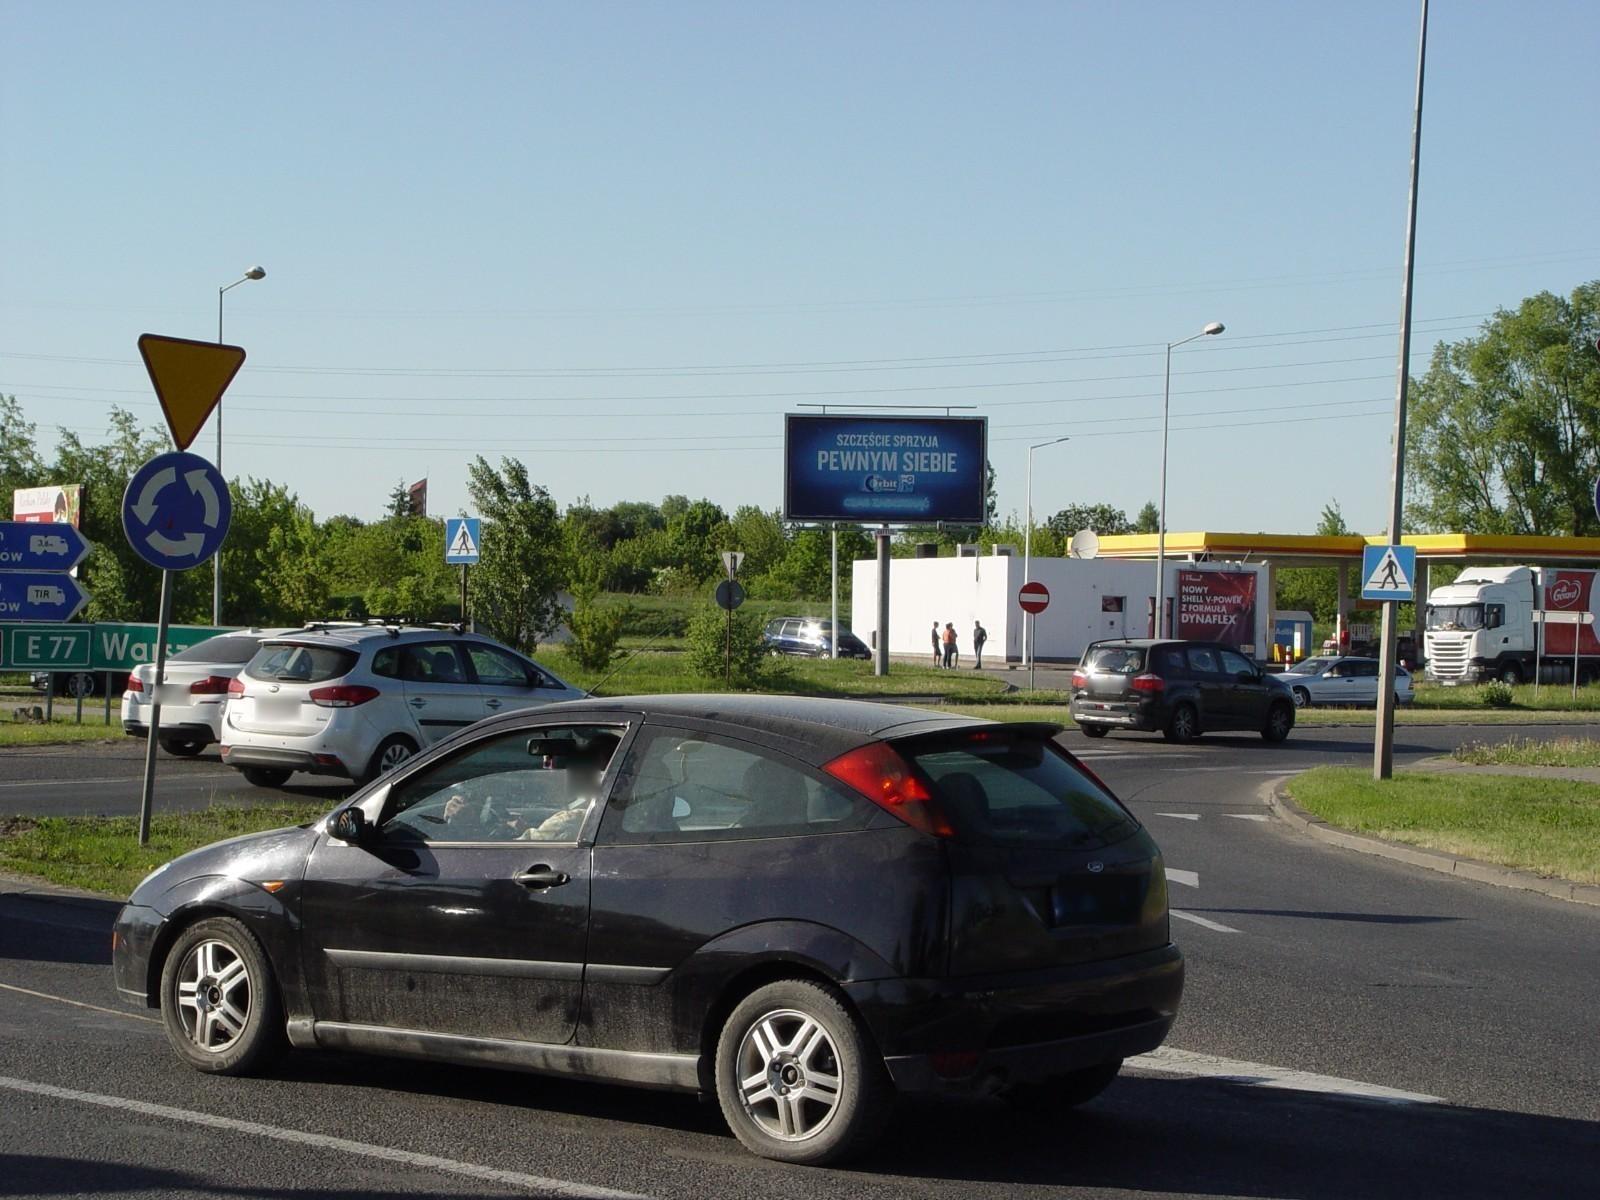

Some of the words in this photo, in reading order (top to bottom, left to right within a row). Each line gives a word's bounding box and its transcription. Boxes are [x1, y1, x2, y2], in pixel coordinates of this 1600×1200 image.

[836, 432, 891, 448] SZCZĘŚCIE
[893, 434, 939, 447] SPRZYJA
[817, 450, 897, 471] PEWNYM
[902, 453, 958, 473] SIEBIE
[34, 589, 50, 599] TIR
[1182, 585, 1209, 594] NOWY
[1182, 594, 1204, 603] SHELL
[1181, 604, 1187, 612] Z
[1181, 613, 1236, 625] DYNAFLEX
[27, 635, 42, 659] E
[49, 636, 77, 660] 77
